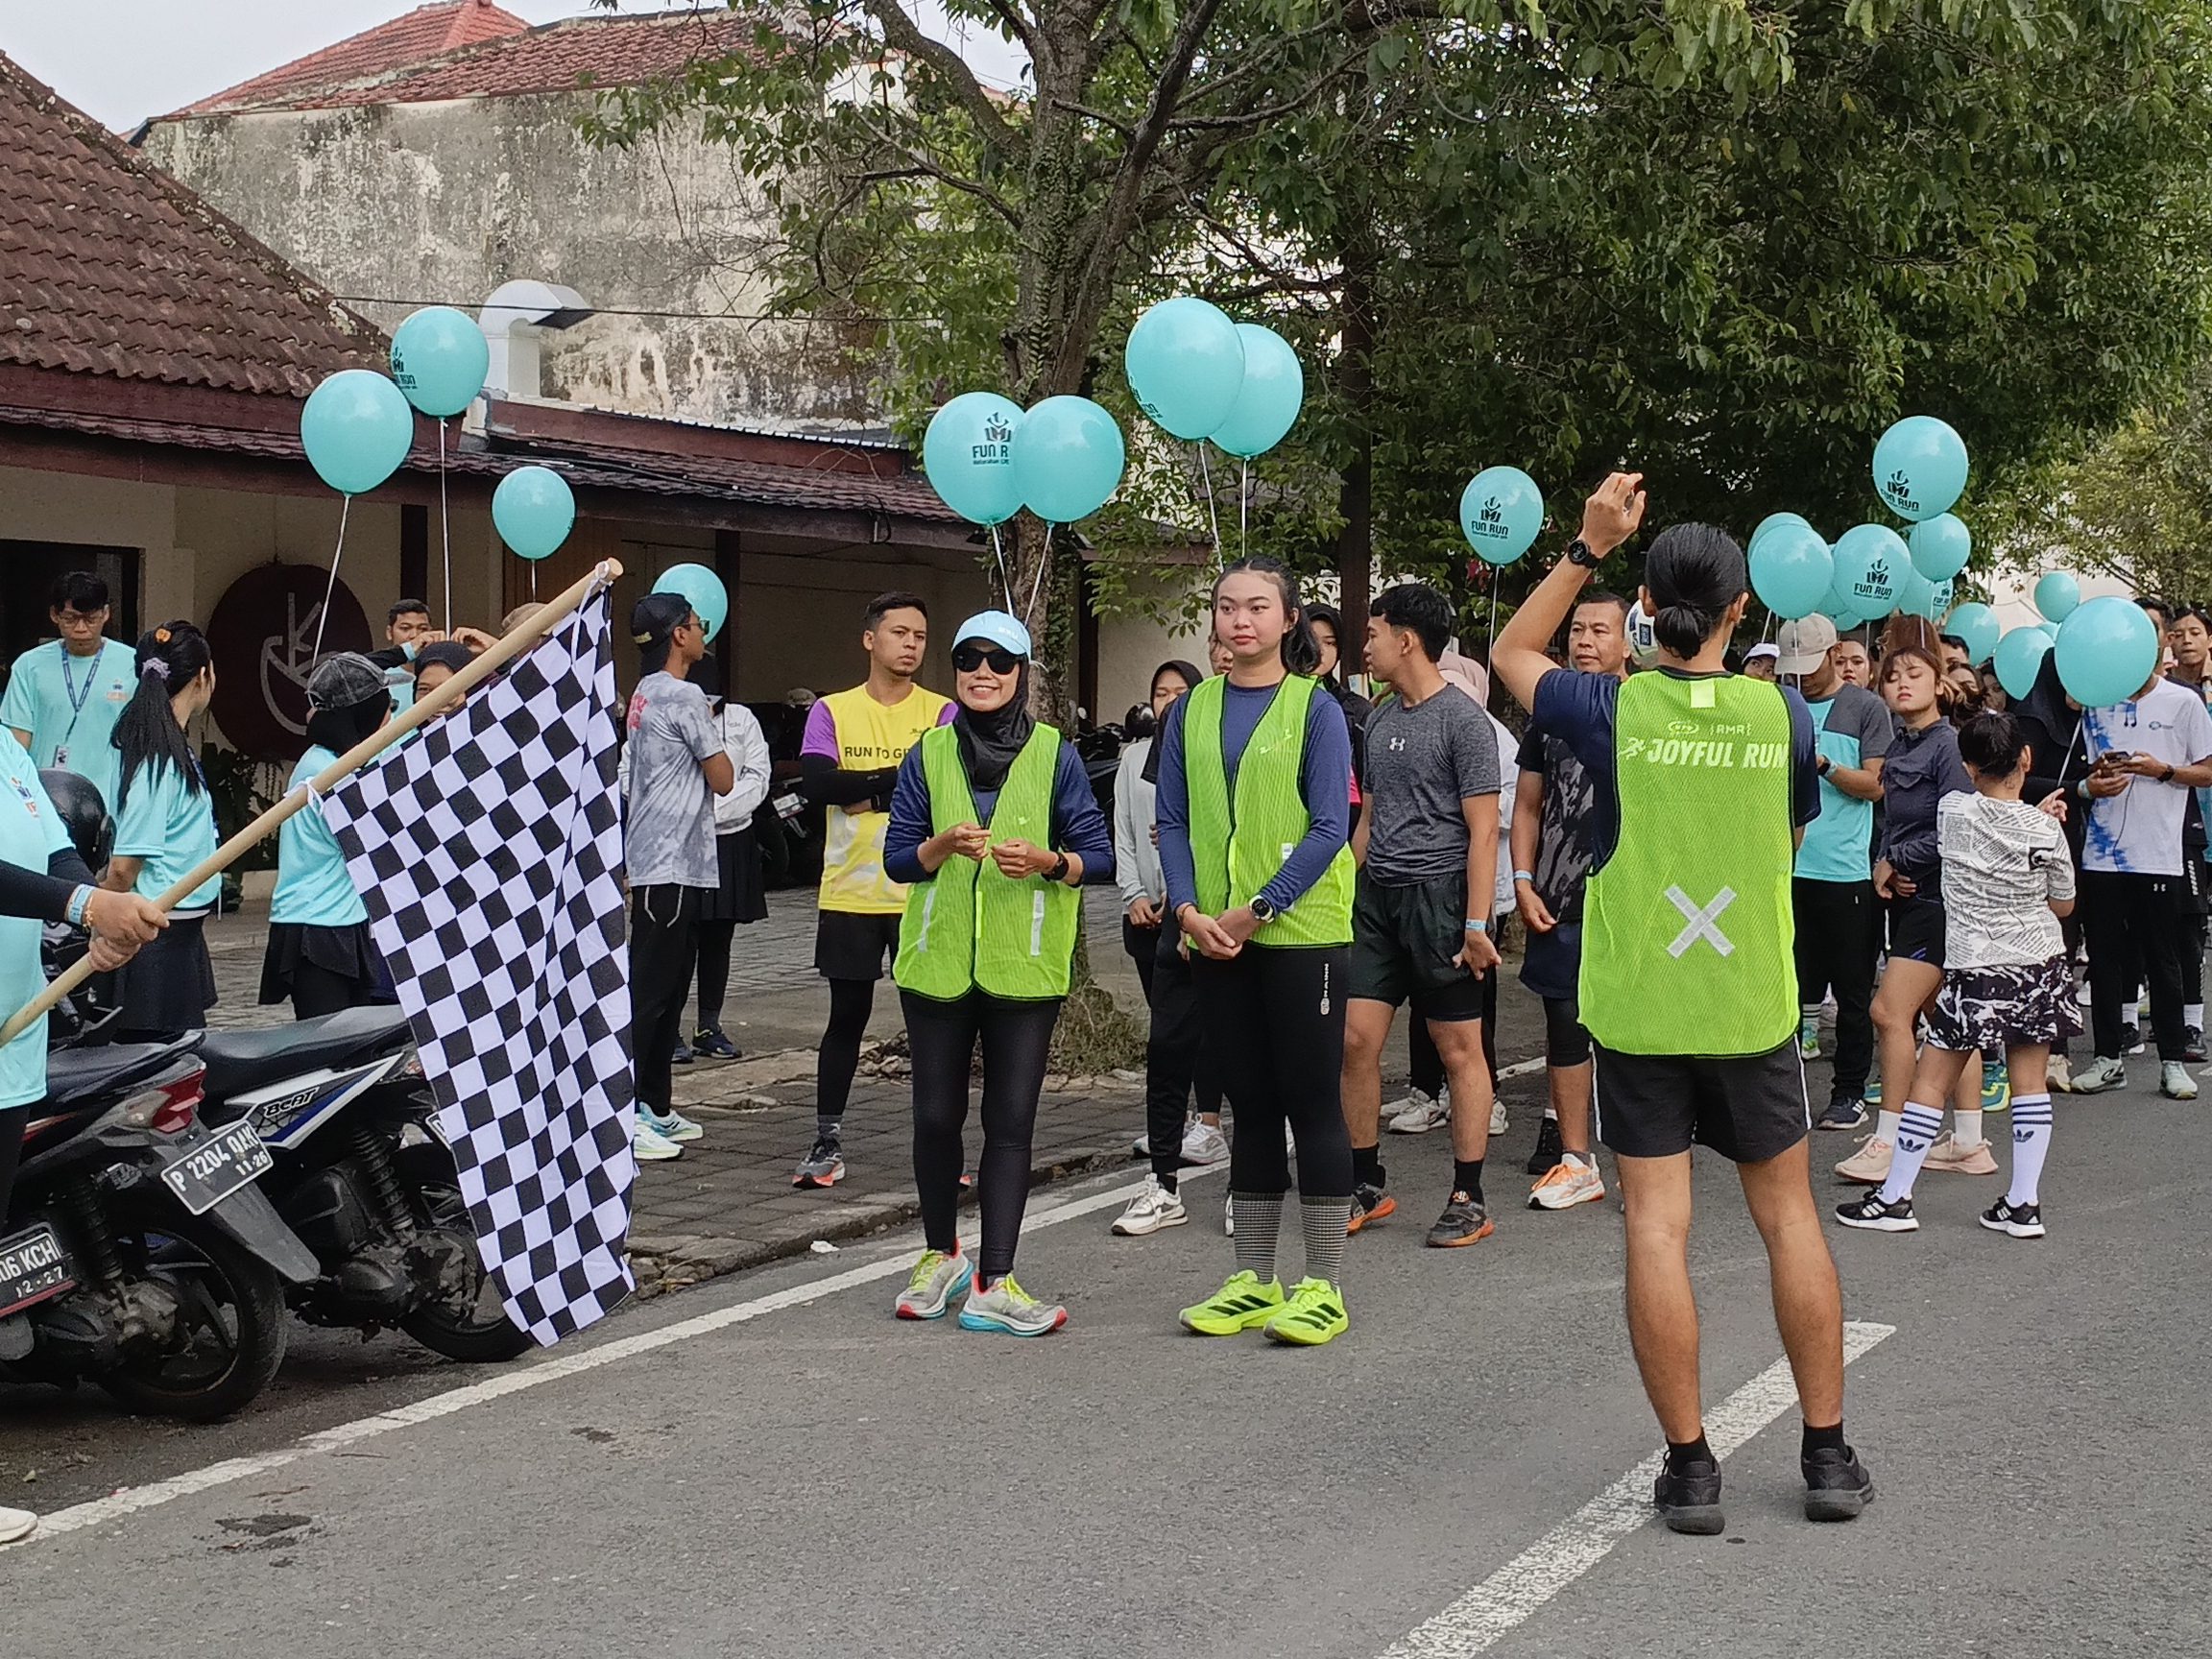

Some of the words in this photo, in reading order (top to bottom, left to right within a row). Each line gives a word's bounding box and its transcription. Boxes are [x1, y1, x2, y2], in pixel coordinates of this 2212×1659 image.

[972, 445, 997, 458] FUN
[1489, 523, 1508, 535] RUN
[1854, 583, 1873, 594] FUN
[1874, 586, 1893, 597] RUN
[845, 746, 873, 757] RUN
[876, 747, 890, 759] TO
[1647, 738, 1734, 767] JOYFUL
[1743, 743, 1790, 769] RUN
[170, 1170, 186, 1191] P
[186, 1143, 231, 1180] 2204
[19, 1239, 59, 1271] KCH
